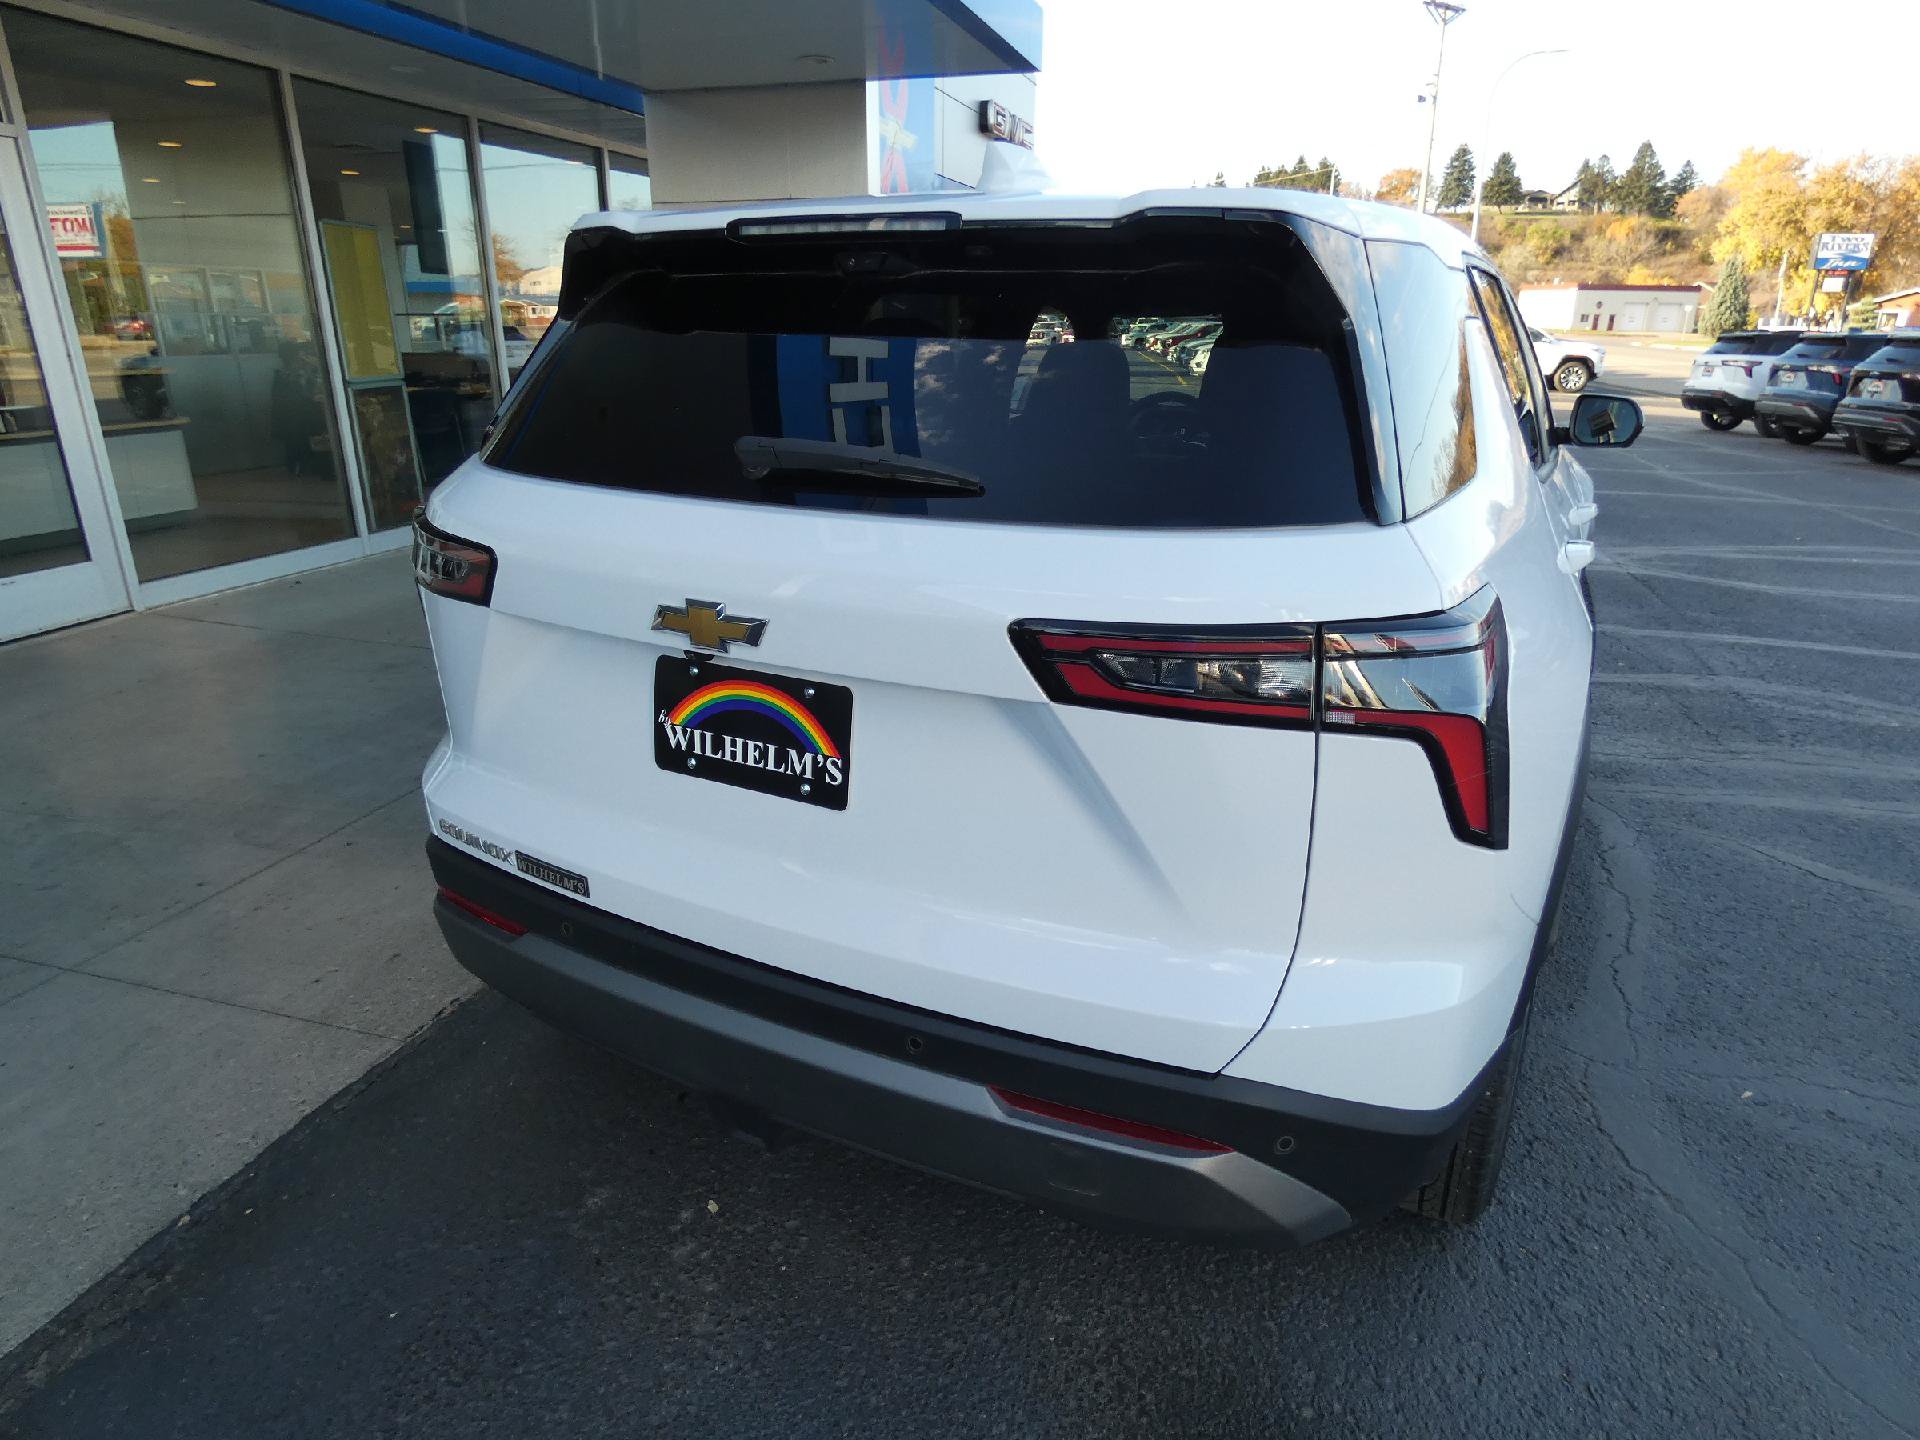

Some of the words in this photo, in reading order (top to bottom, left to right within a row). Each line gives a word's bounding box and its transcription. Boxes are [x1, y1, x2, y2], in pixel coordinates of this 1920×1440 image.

[980, 100, 1033, 149] GMC
[1820, 257, 1863, 269] Inn
[664, 724, 842, 785] WILHELM'S
[438, 818, 515, 866] EQUINOX
[517, 857, 585, 895] WILHELM'S
